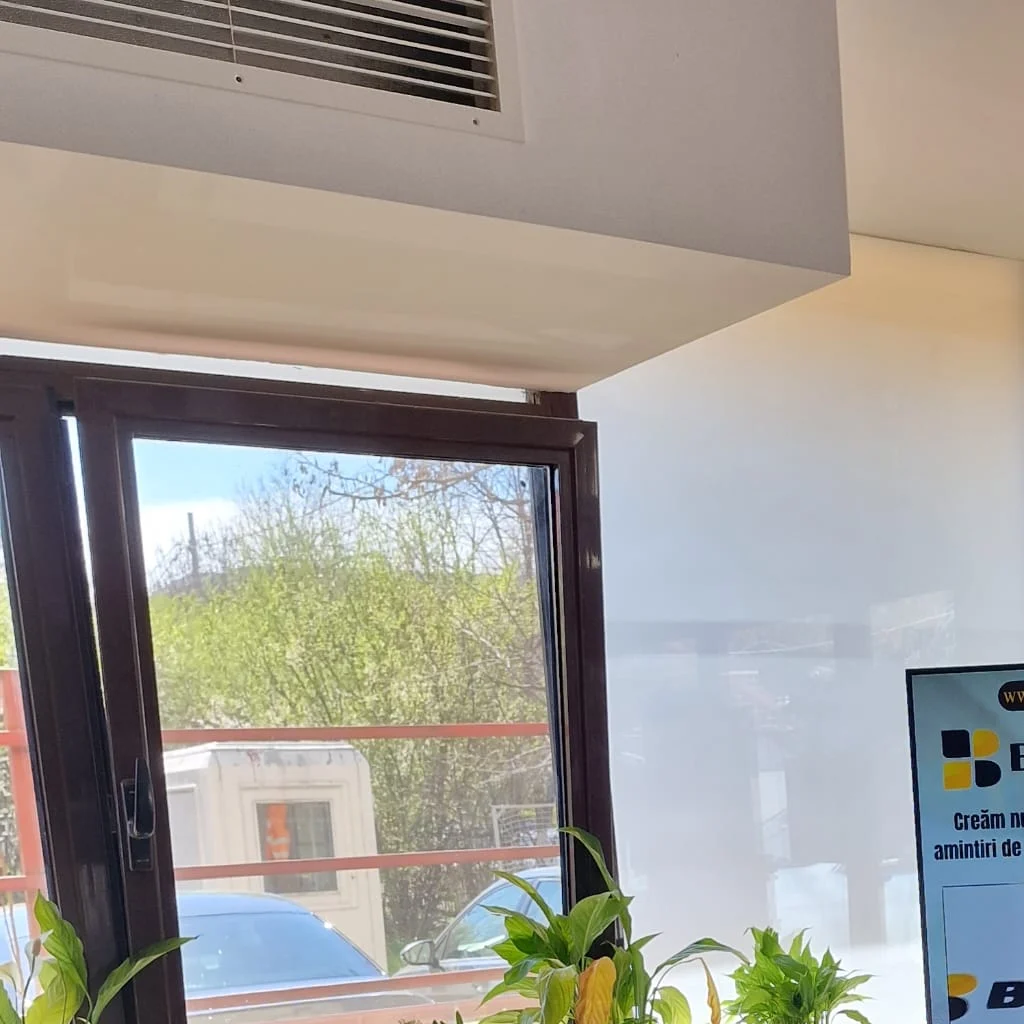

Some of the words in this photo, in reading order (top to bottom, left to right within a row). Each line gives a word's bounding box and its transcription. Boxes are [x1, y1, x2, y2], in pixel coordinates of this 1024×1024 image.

[953, 809, 1006, 831] Creăm
[934, 838, 997, 860] amintiri
[1001, 838, 1022, 857] de
